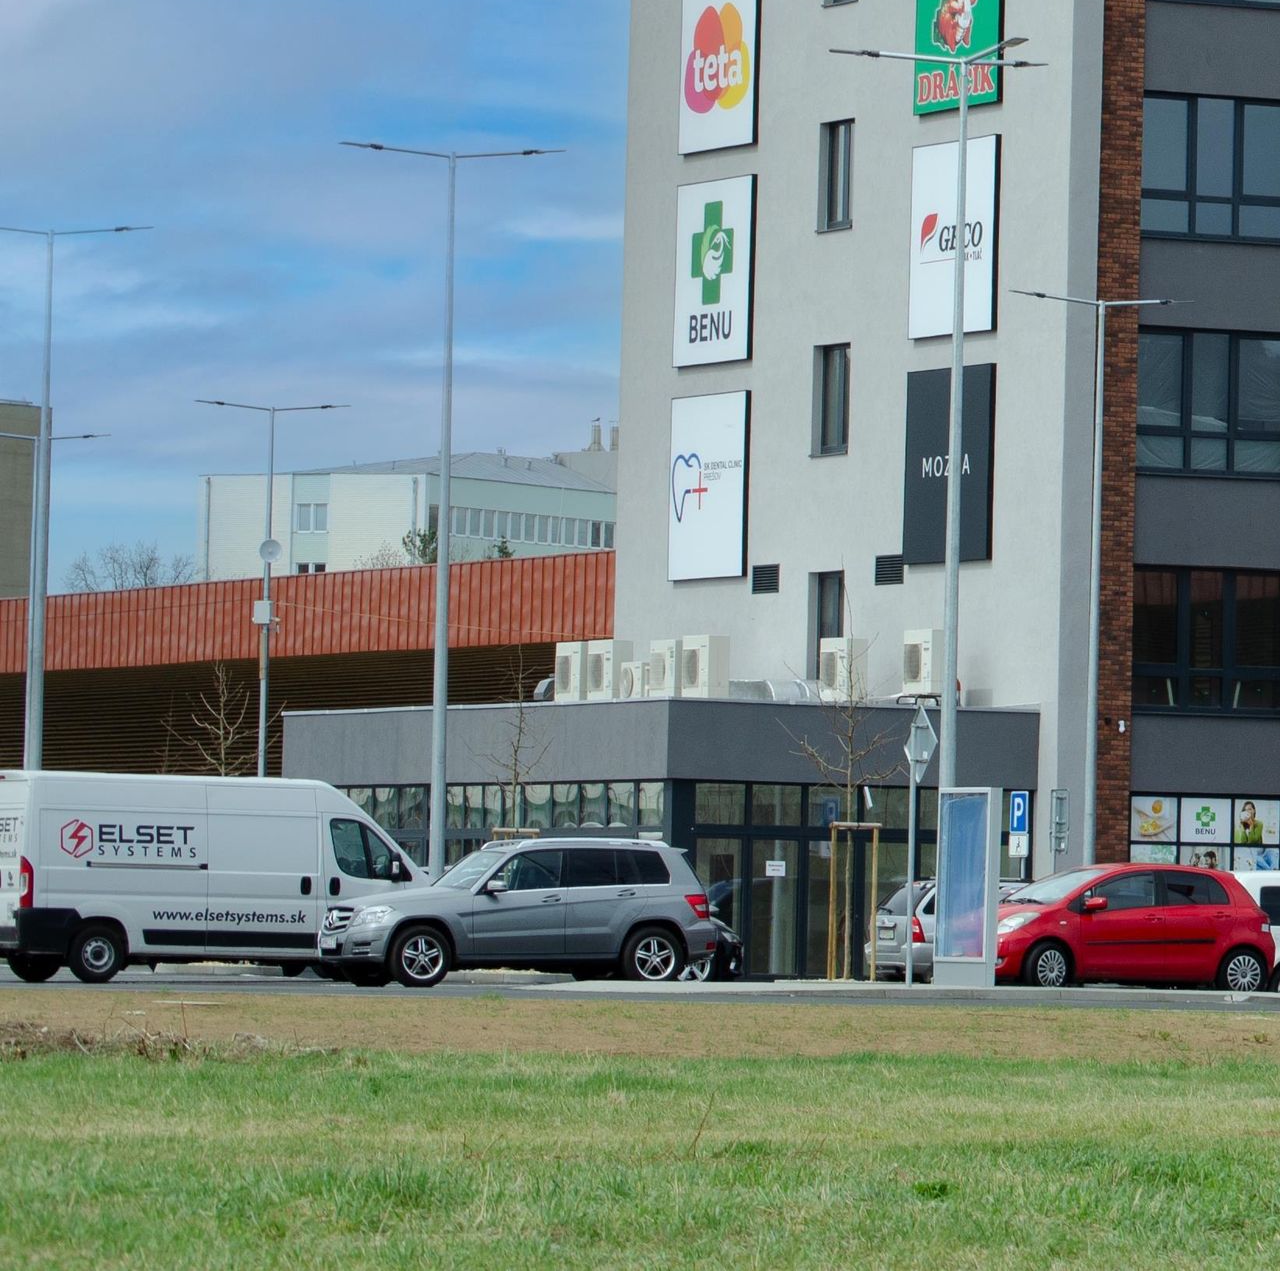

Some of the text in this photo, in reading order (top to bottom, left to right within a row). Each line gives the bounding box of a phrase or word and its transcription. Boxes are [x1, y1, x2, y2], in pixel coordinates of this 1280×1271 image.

[693, 44, 743, 93] teta
[689, 310, 732, 344] BENU
[922, 453, 971, 479] MOZA
[1013, 797, 1024, 828] P
[98, 824, 195, 845] ELSET
[98, 845, 197, 858] SYSTEMS
[152, 907, 307, 926] www.elsetsystems.sk
